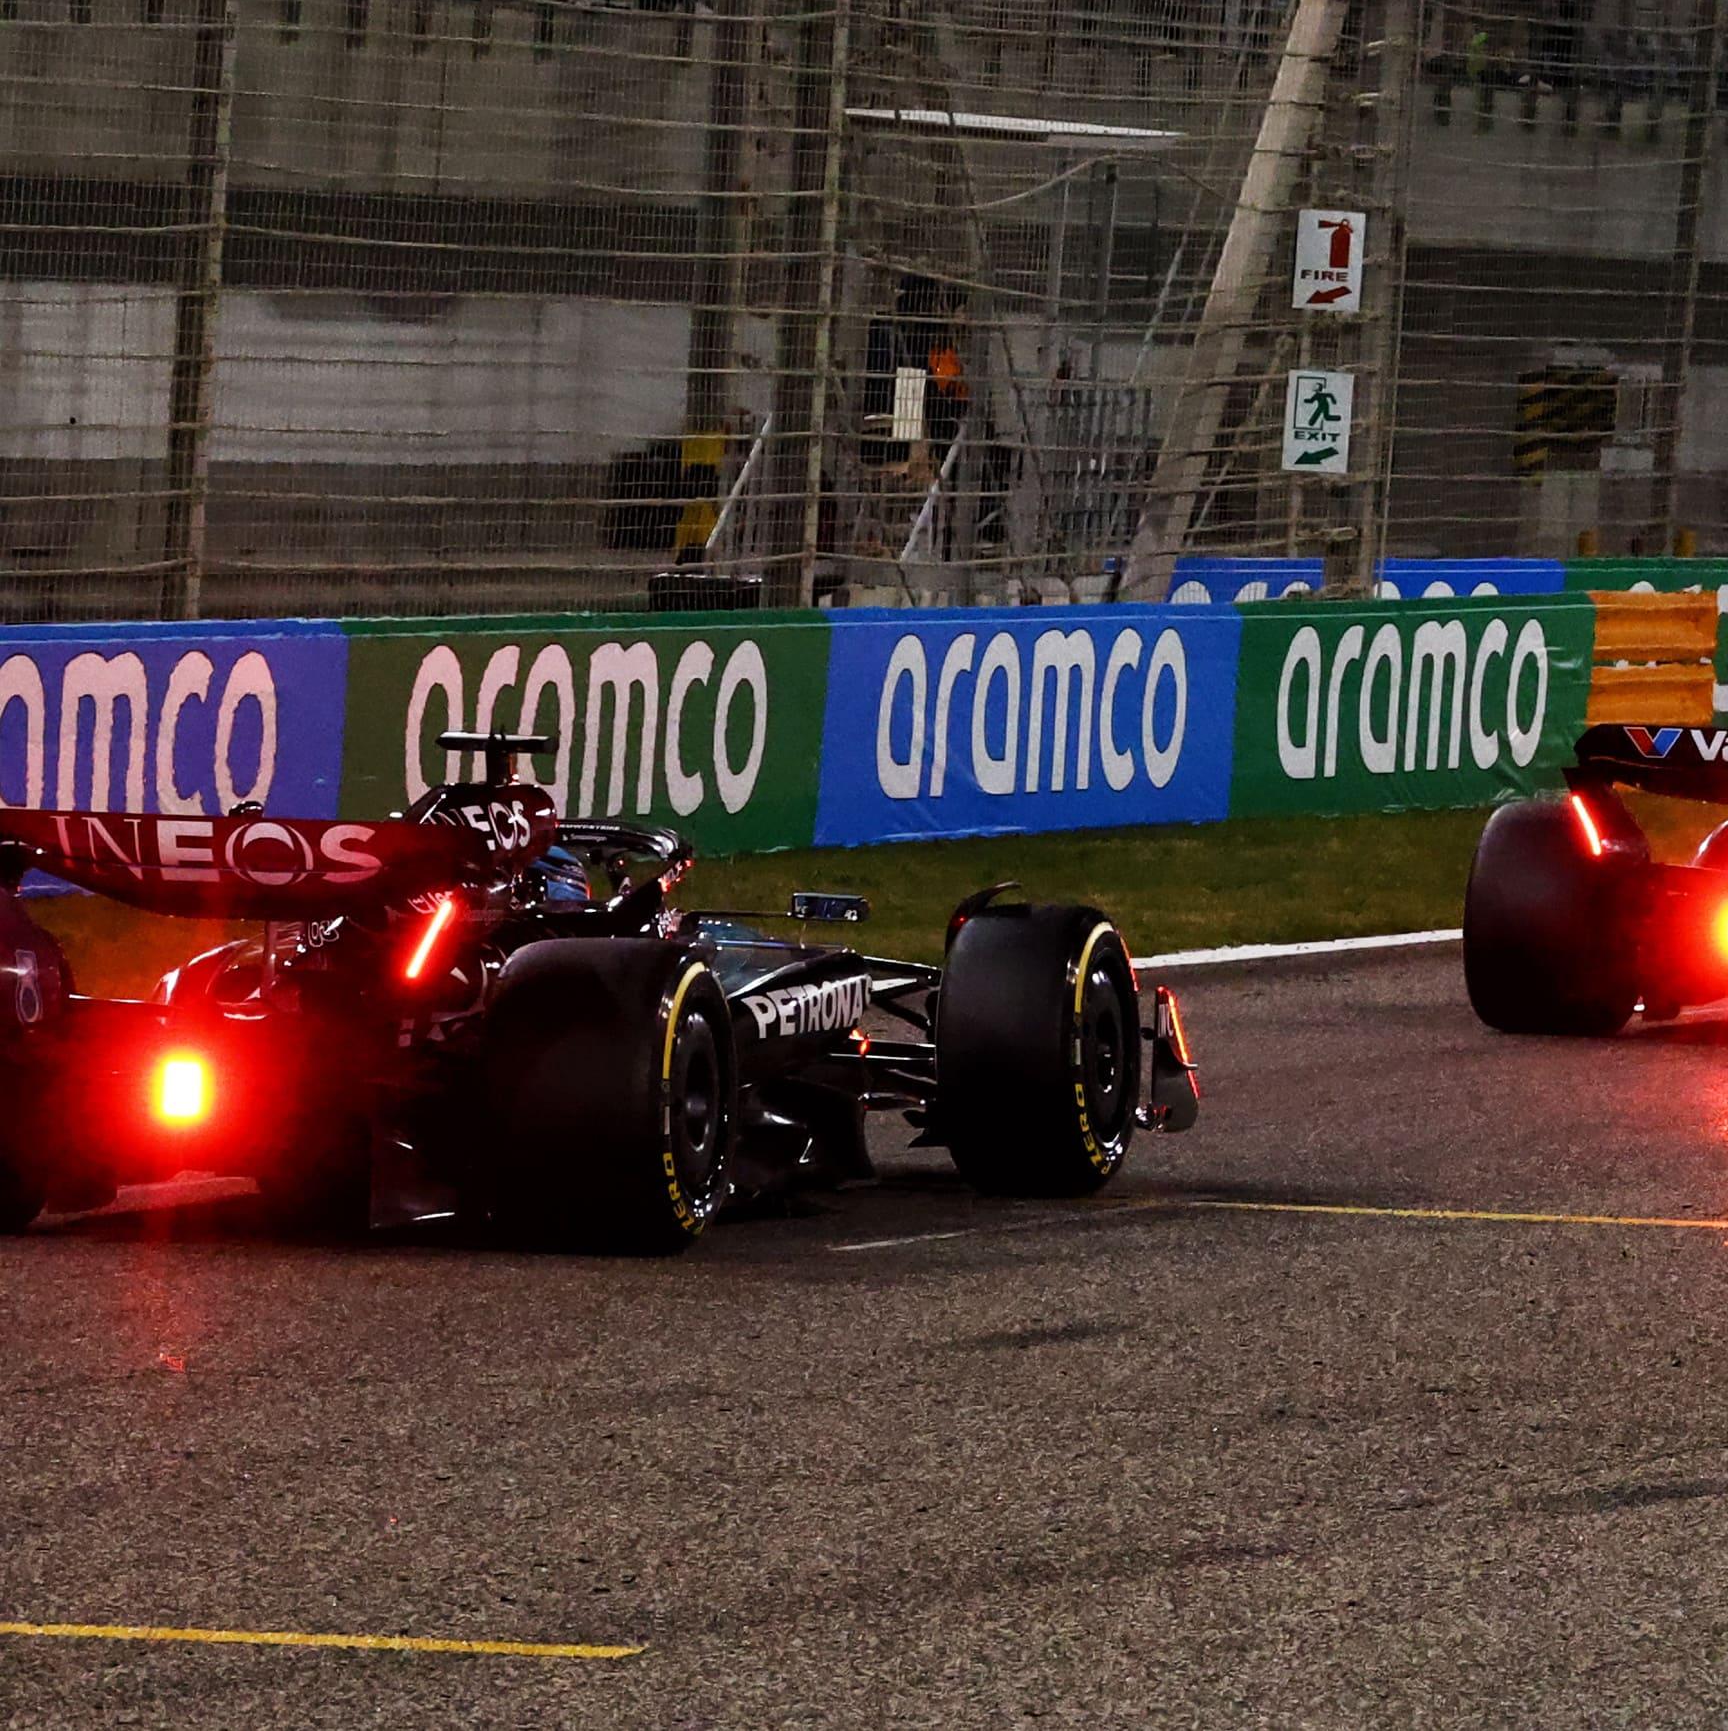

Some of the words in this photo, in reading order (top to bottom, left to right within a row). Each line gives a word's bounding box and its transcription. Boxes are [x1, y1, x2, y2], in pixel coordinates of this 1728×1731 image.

[1300, 270, 1349, 282] FIRE
[1293, 431, 1341, 443] EXIT
[0, 651, 277, 817] amco
[405, 640, 768, 817] aramco
[876, 626, 1188, 799] aramco
[1277, 618, 1548, 779] aramco
[50, 815, 383, 885] INEOS
